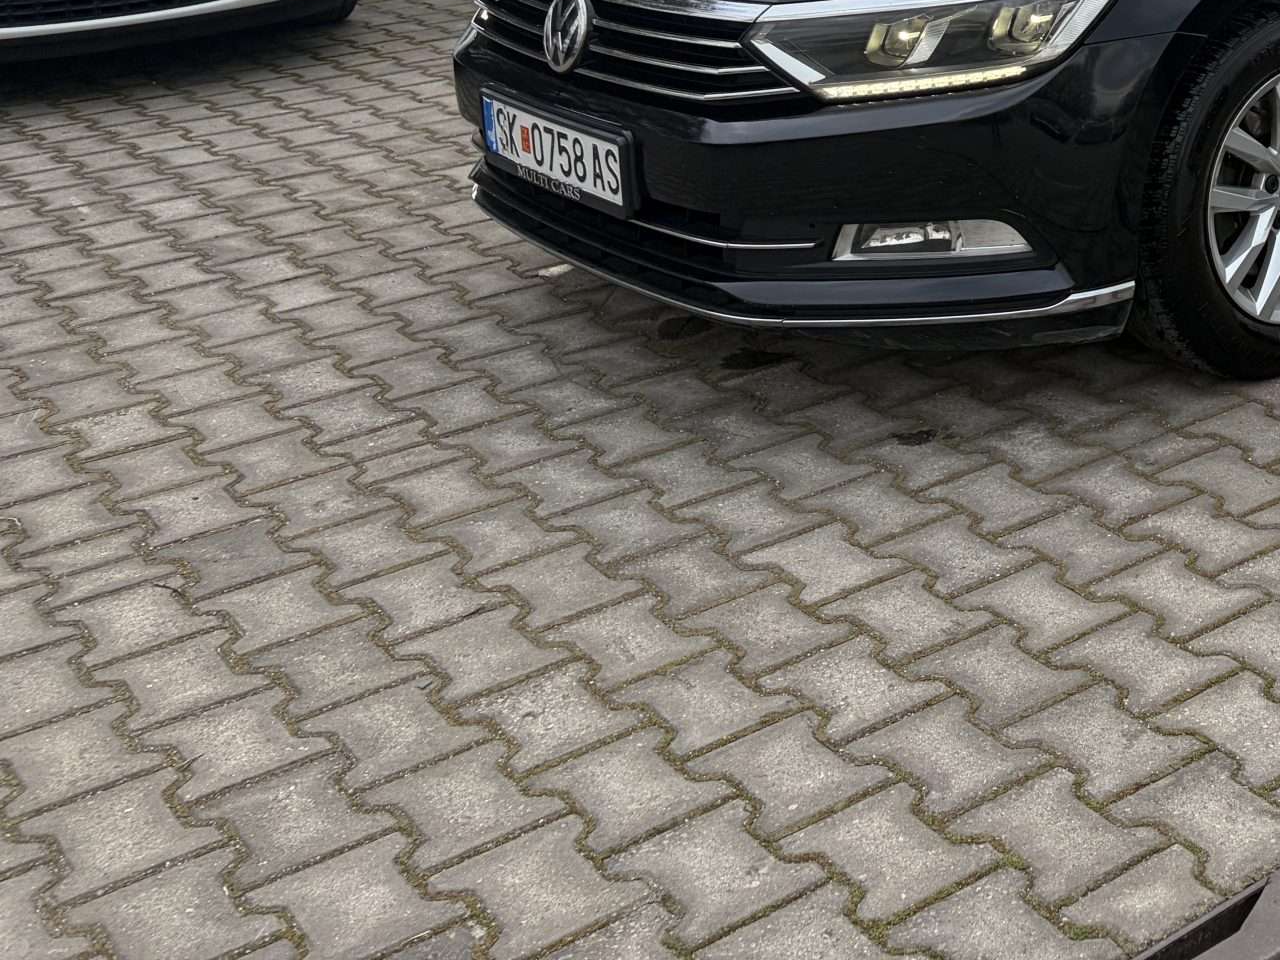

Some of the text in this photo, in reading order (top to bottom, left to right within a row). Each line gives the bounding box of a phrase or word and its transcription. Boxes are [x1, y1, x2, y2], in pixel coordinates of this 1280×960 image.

[496, 107, 520, 158] SK
[531, 122, 587, 183] 0758
[592, 143, 620, 195] AS
[517, 164, 581, 200] MULTI CARS
